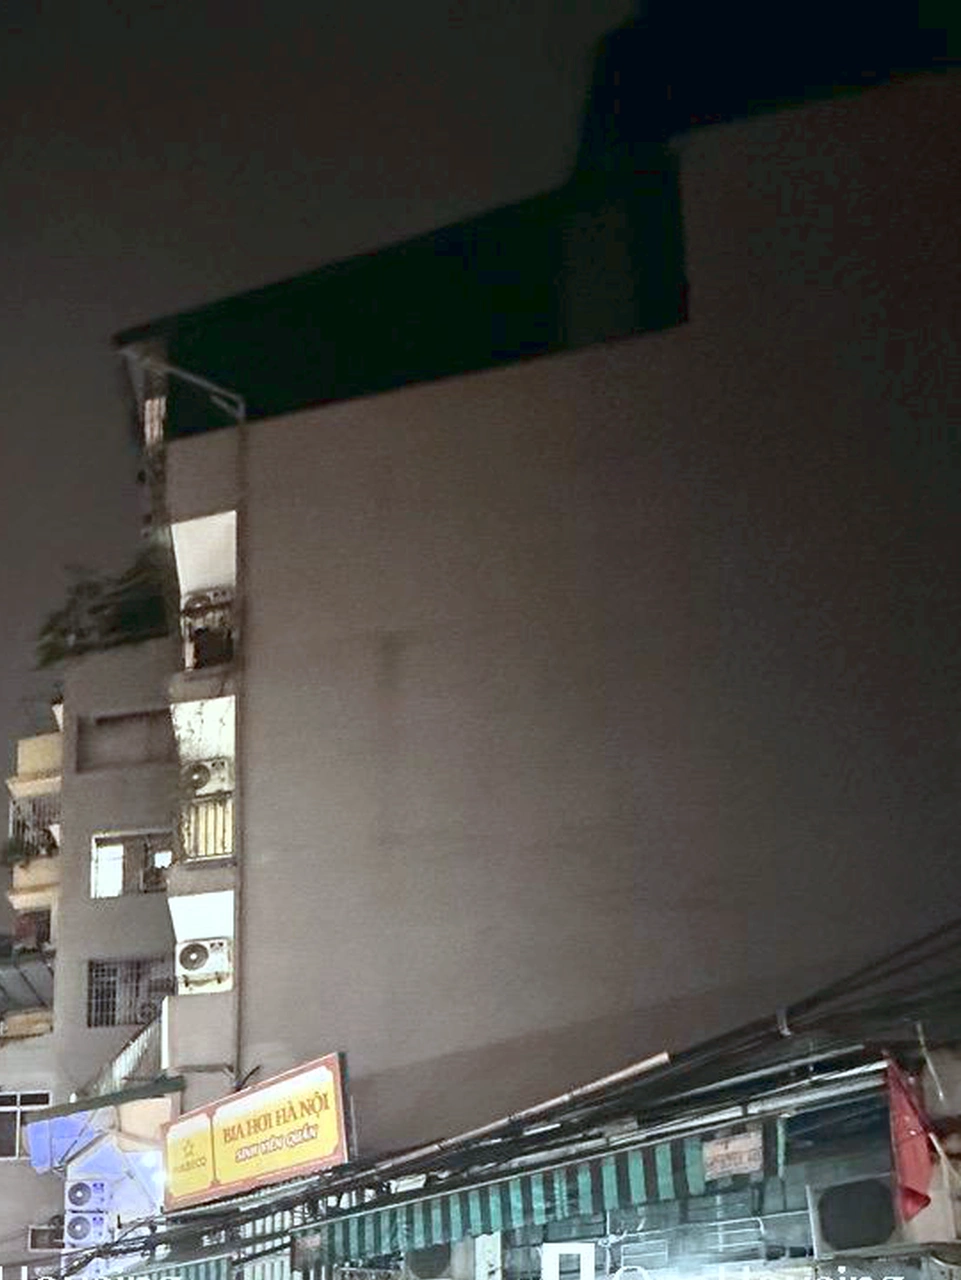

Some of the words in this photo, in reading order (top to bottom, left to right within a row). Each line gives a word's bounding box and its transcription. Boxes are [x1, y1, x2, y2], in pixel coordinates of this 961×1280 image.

[223, 1121, 245, 1144] BIA
[275, 1099, 299, 1125] HÀ
[300, 1090, 331, 1118] NỘI
